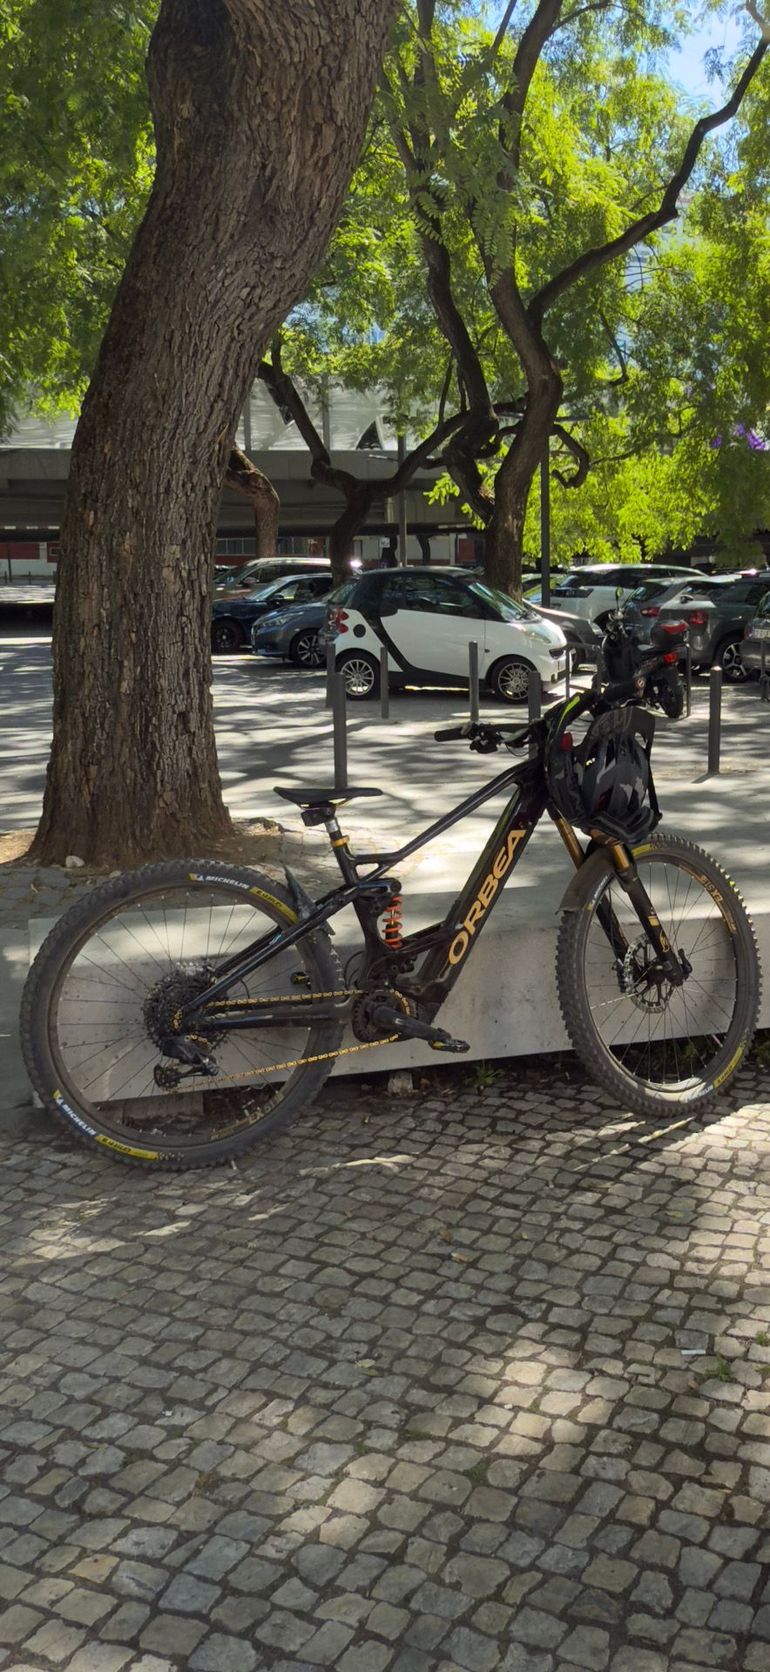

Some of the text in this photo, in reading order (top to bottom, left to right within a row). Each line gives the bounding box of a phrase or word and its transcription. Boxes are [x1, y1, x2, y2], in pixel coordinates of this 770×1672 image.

[205, 876, 251, 889] MICHELIN
[449, 829, 527, 965] ORBEA
[61, 1104, 97, 1136] MICHELIN
